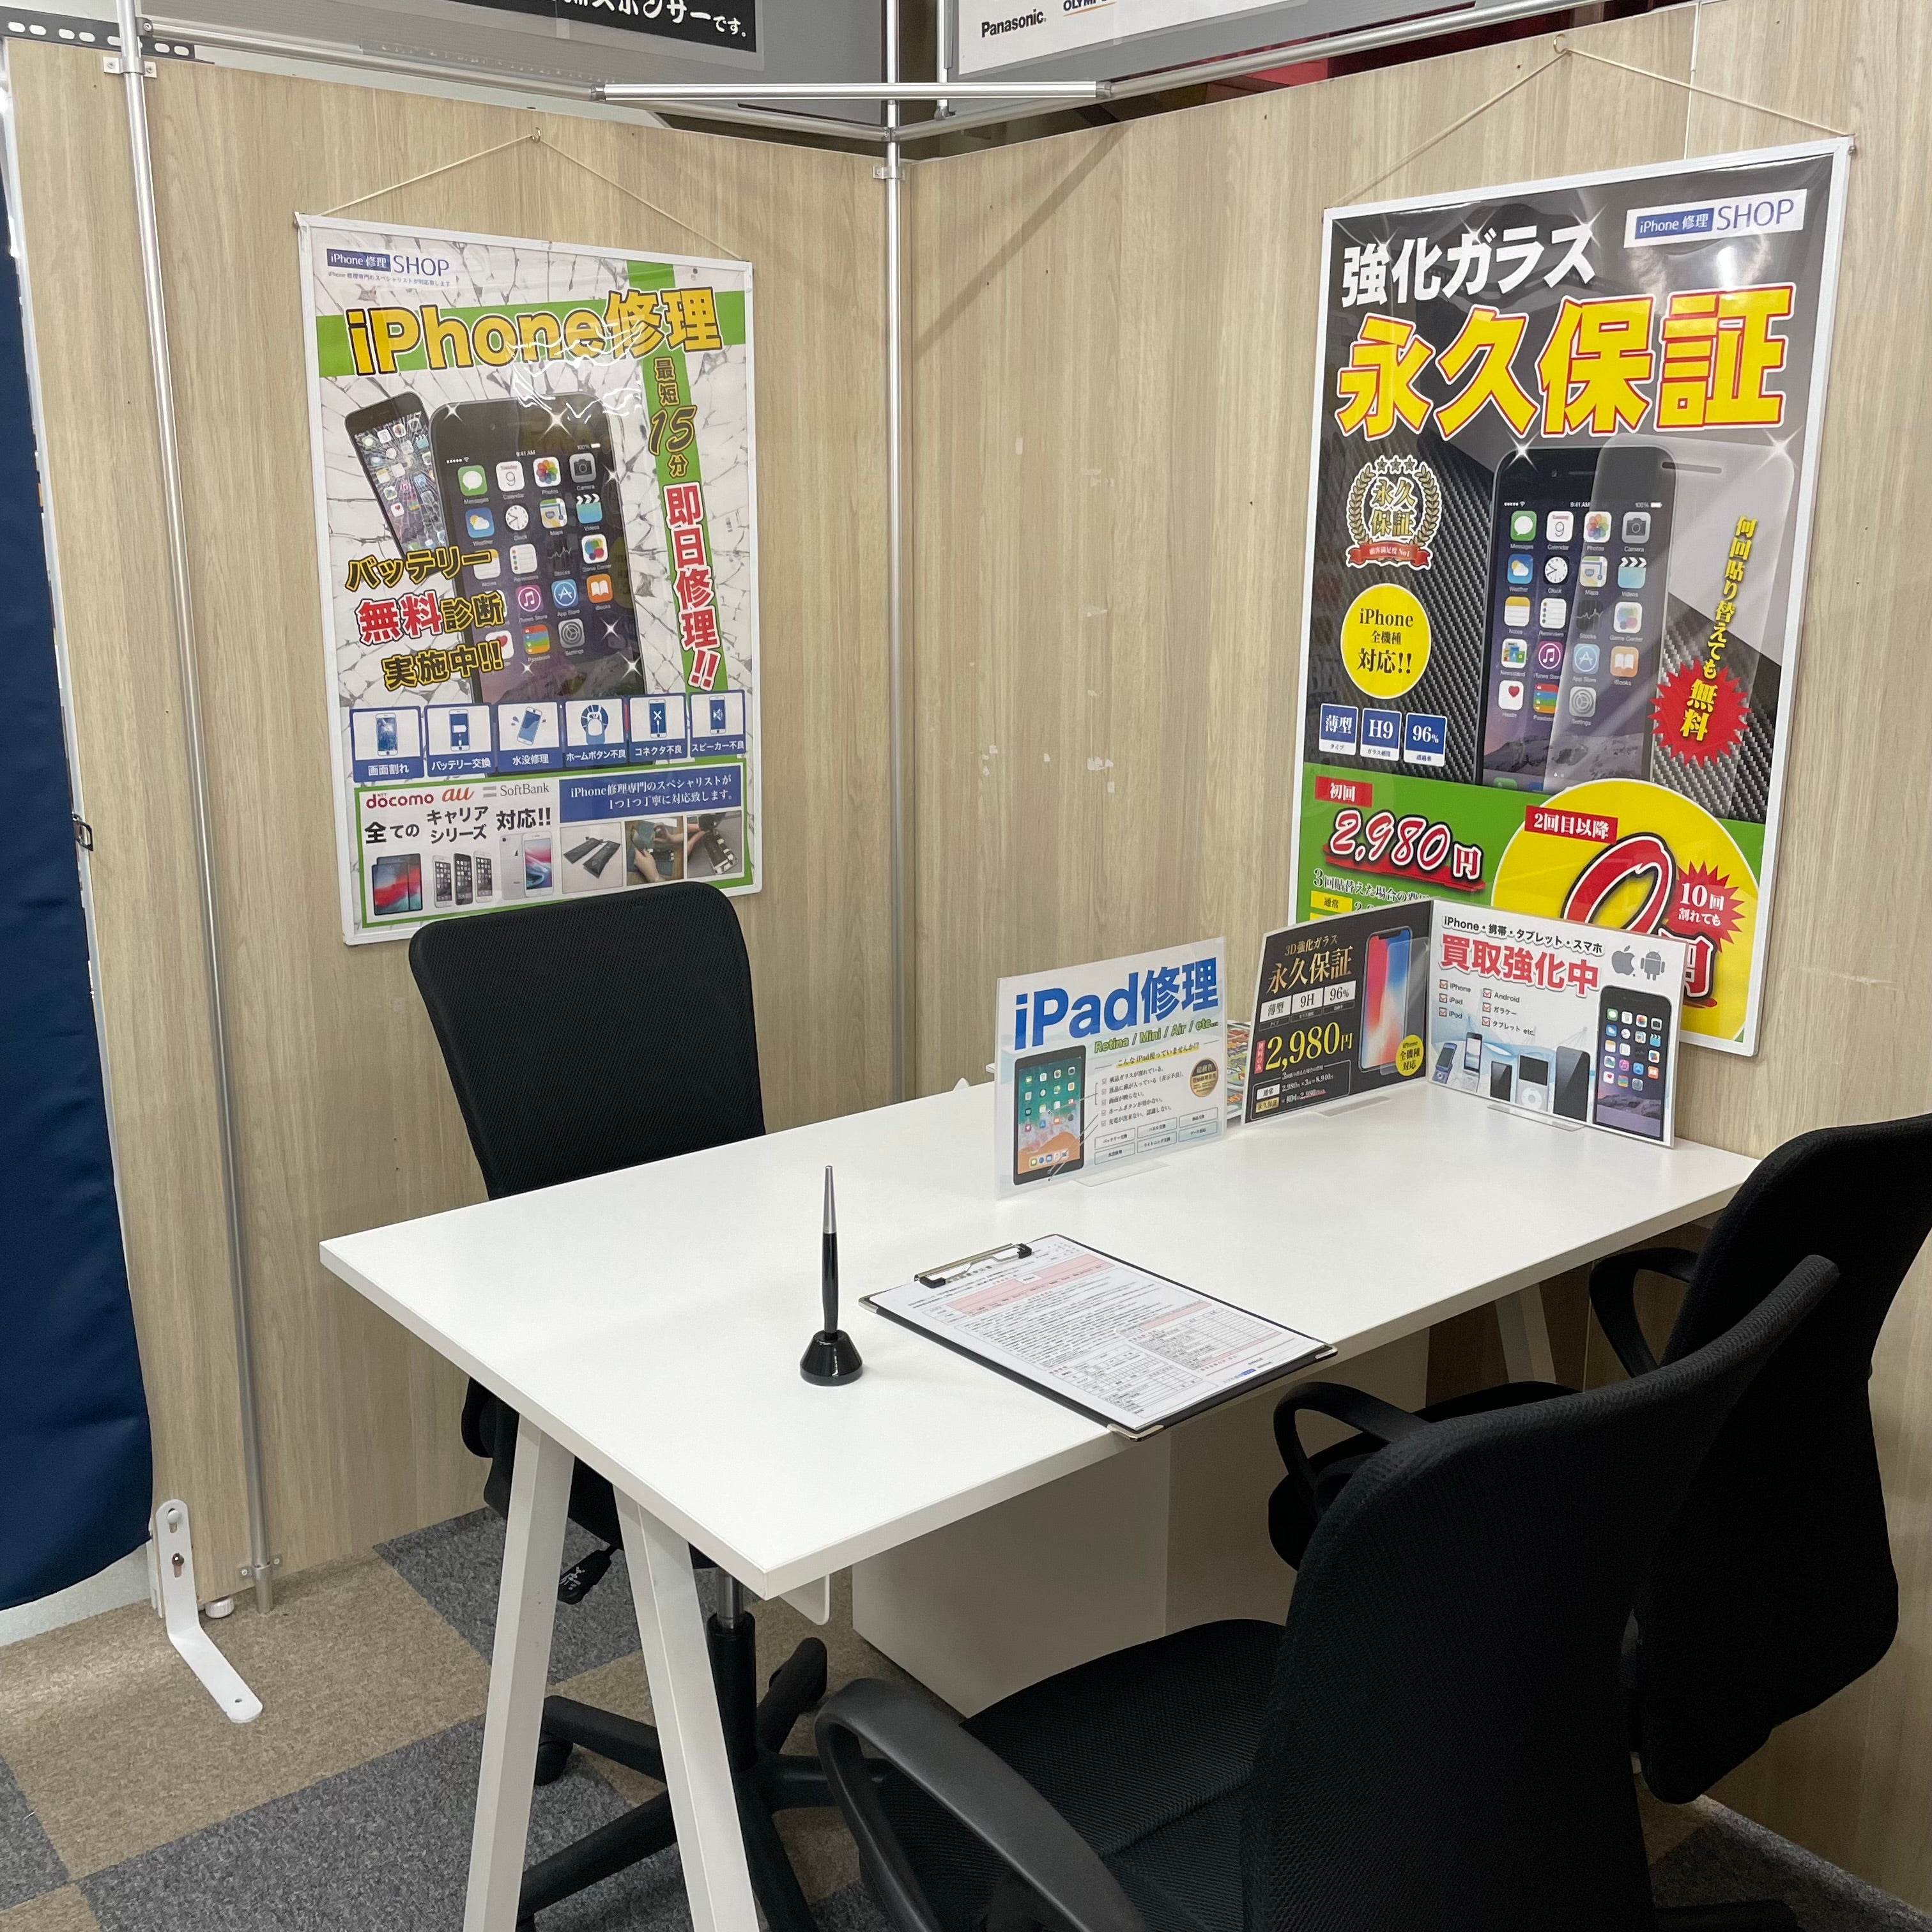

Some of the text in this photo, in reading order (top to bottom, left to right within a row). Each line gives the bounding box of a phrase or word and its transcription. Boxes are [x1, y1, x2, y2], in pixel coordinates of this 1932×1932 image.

[564, 0, 746, 37] スポンサーです。
[981, 9, 1045, 38] Panasonic
[1639, 199, 1794, 234] iPhone 修理 SHOP
[331, 253, 449, 276] iPhone 修理 SHOP
[1342, 223, 1595, 307] 強化ガラス
[345, 286, 723, 376] iPhone修理
[1337, 283, 1795, 441] 永久保証
[505, 471, 516, 486] 9
[1372, 479, 1415, 506] 永久
[648, 357, 721, 691] 最短15分 即日修理!!
[1371, 510, 1414, 537] 保証
[1555, 521, 1565, 537] 9
[346, 546, 492, 592] バッテリー
[355, 589, 505, 646] 無料診断
[1360, 608, 1414, 627] iPhone
[1679, 515, 1758, 741] 何回貼り替えても 無料
[1371, 630, 1402, 645] 全機種
[381, 640, 505, 691] 実施中!!
[1356, 648, 1412, 674] 対応!!
[1325, 714, 1352, 734] 薄型
[1368, 719, 1393, 739] H9
[1413, 725, 1439, 744] 96%
[566, 749, 626, 762] ホームボタン不良
[635, 745, 682, 756] コネクタ不良
[691, 740, 744, 753] スピーカー不良
[368, 763, 409, 776] 画面割れ
[431, 757, 491, 771] バッテリー交換
[512, 754, 549, 765] 水没修理
[441, 786, 475, 802] au
[500, 783, 549, 797] SoftBank
[571, 774, 732, 798] iPhone修理専門のスペシャリストが
[1330, 782, 1356, 802] 初回
[365, 793, 434, 808] docomo
[427, 806, 489, 825] キャリア
[496, 807, 551, 831] 対応!!
[1533, 813, 1609, 839] 2回目以降
[364, 821, 420, 844] 全ての
[430, 824, 487, 845] シリーズ
[1330, 809, 1482, 880] 2,980円
[1314, 868, 1429, 901] 3回貼替えた場合の
[1323, 897, 1339, 908] 通常
[1680, 882, 1724, 911] 10回
[1678, 907, 1721, 926] 割れても
[1284, 935, 1338, 956] 3D強化ガラス
[1266, 946, 1353, 994] 永久保証
[1440, 935, 1598, 995] 買取強化中
[1330, 986, 1349, 1001] 96%
[1449, 983, 1471, 992] iPhone
[1494, 992, 1520, 1003] Android
[1014, 956, 1218, 1051] iPad修理
[1300, 993, 1315, 1008] 9H
[1449, 997, 1462, 1005] iPad
[1493, 1006, 1517, 1015] ガラケー
[1449, 1011, 1462, 1019] iPod
[1492, 1020, 1520, 1031] タブレット
[1094, 1037, 1129, 1054] Retina
[1140, 1029, 1161, 1043] Mini
[1170, 1023, 1186, 1037] Air
[1266, 1022, 1353, 1071] 2,980円
